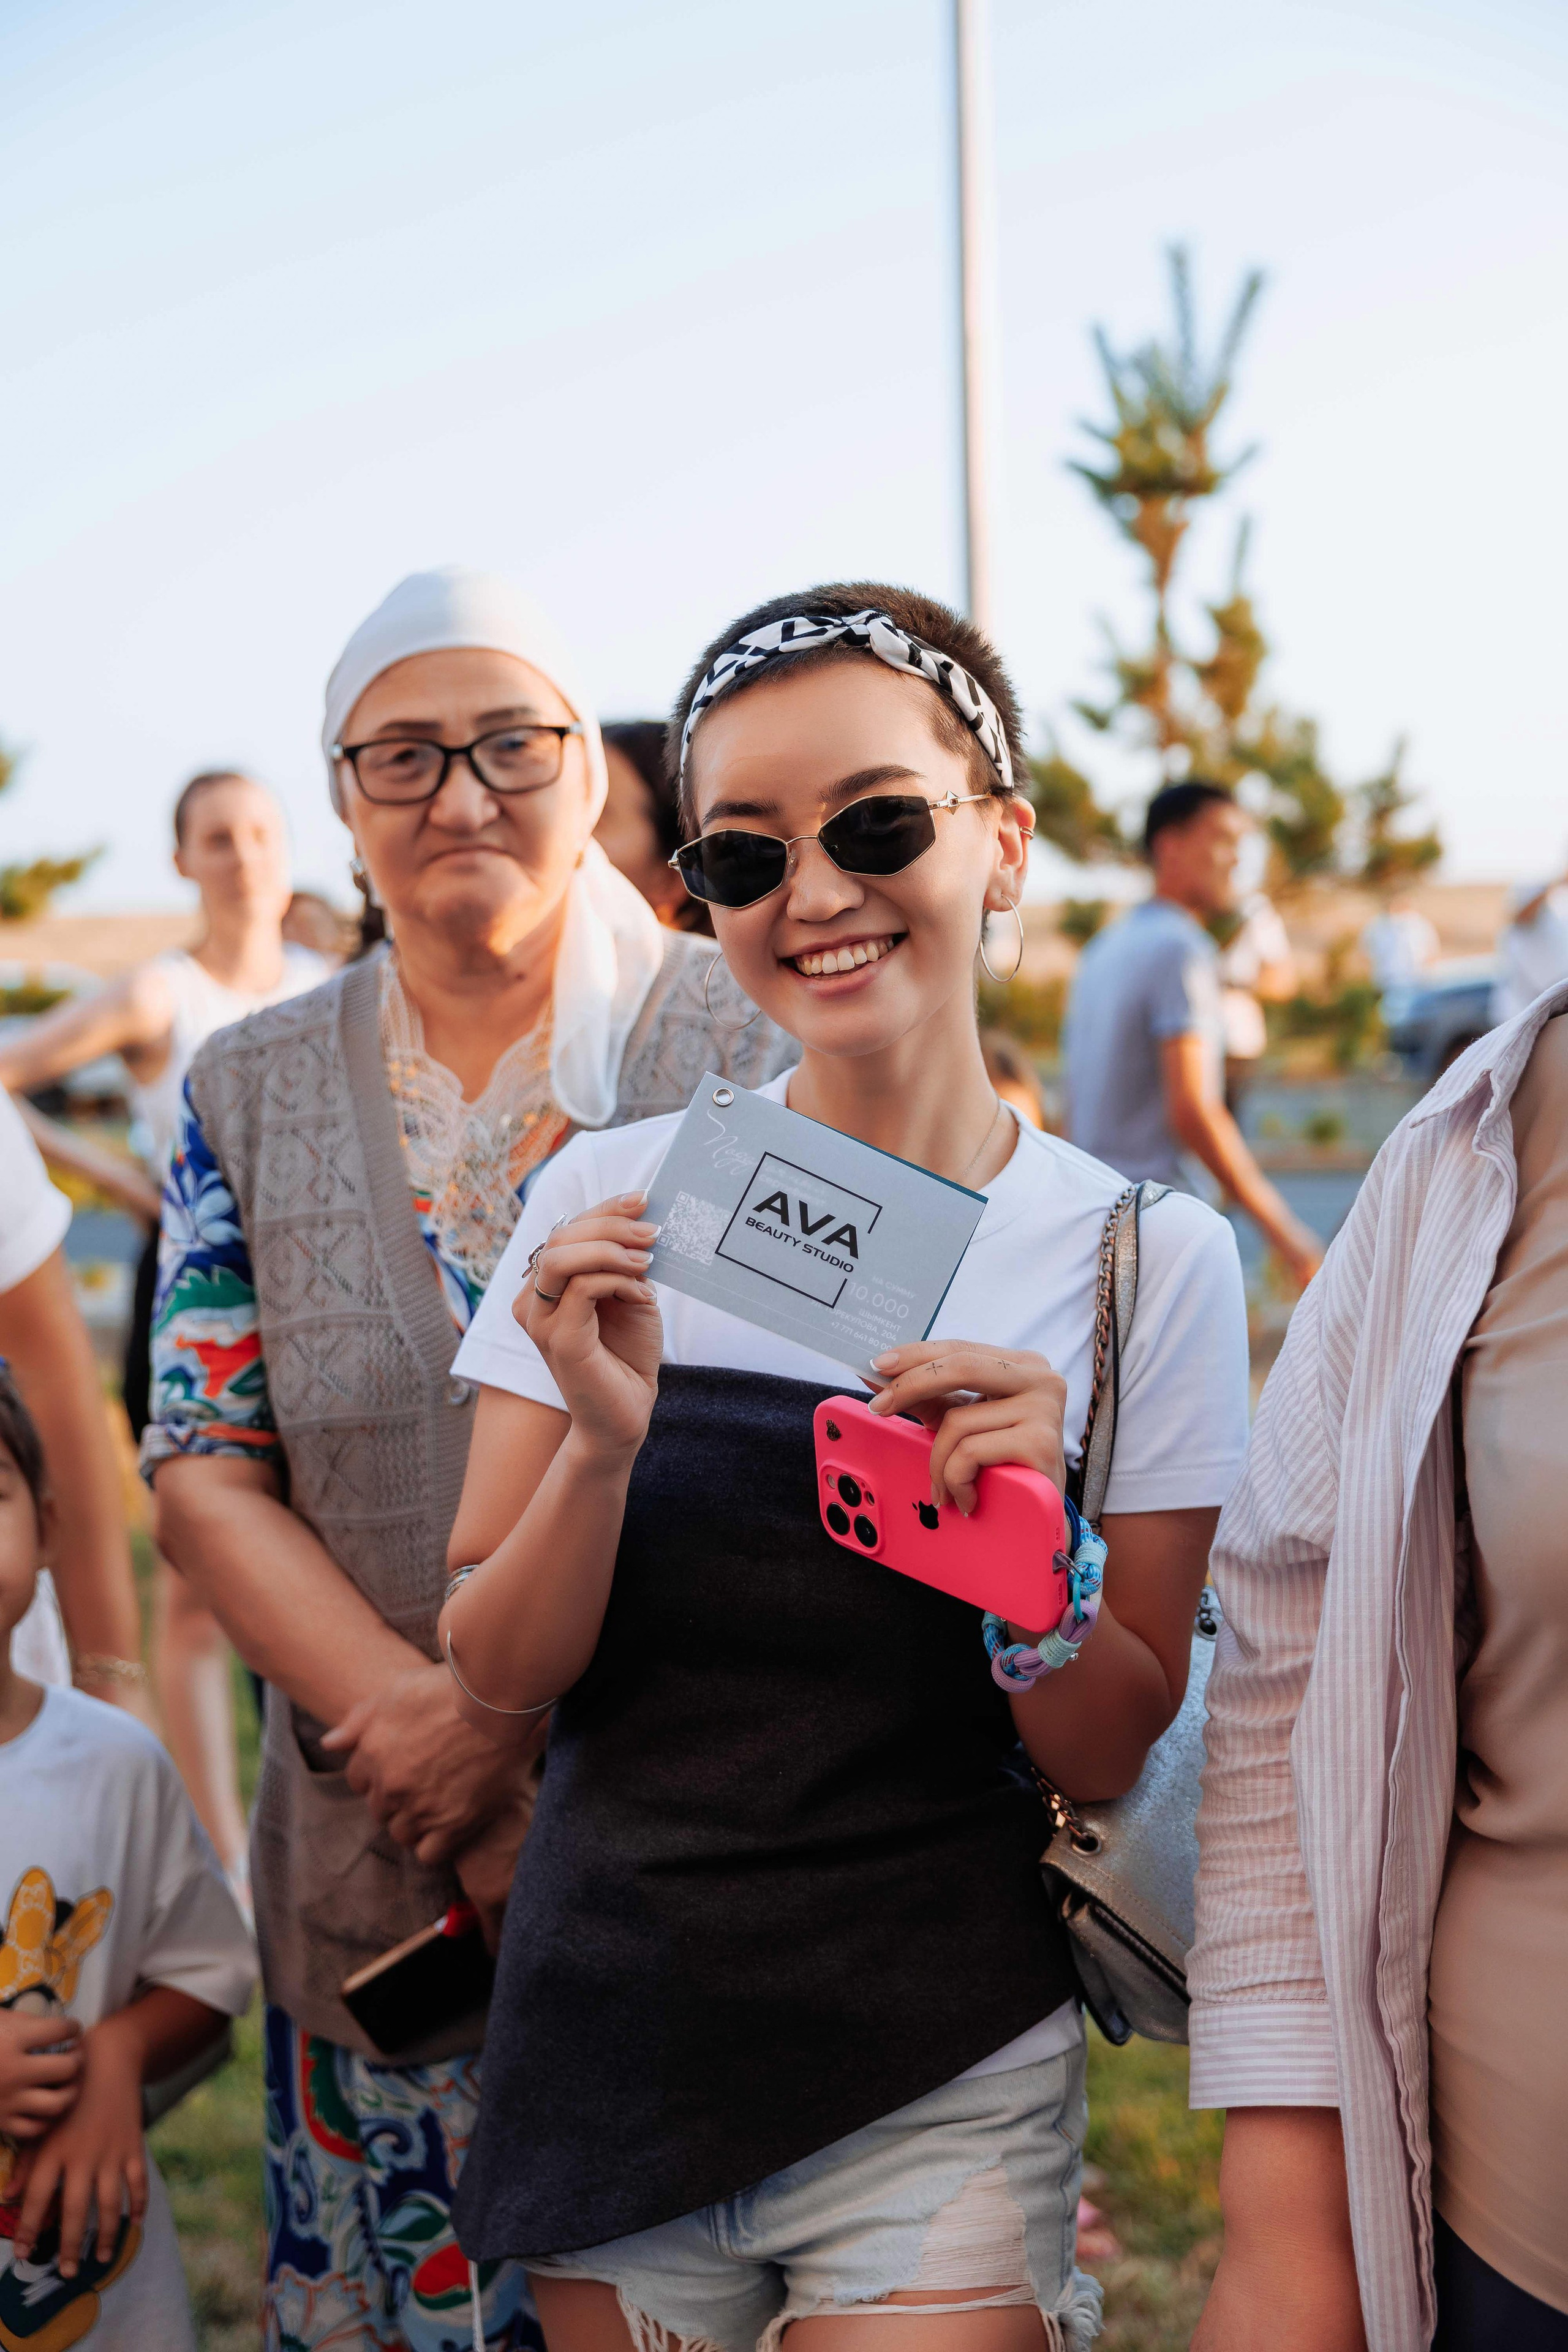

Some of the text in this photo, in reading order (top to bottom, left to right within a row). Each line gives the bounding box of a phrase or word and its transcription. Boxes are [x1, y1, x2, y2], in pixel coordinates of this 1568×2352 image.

[753, 1191, 859, 1259] AVA
[745, 1216, 854, 1273] BEAUTY STUDIO
[848, 1281, 909, 1318] 10.000
[885, 1281, 916, 1298] СУММУ
[858, 1308, 902, 1332] ШЫМКЕНТ
[840, 1324, 853, 1335] 771
[853, 1331, 867, 1341] 641
[881, 1329, 896, 1341] 204
